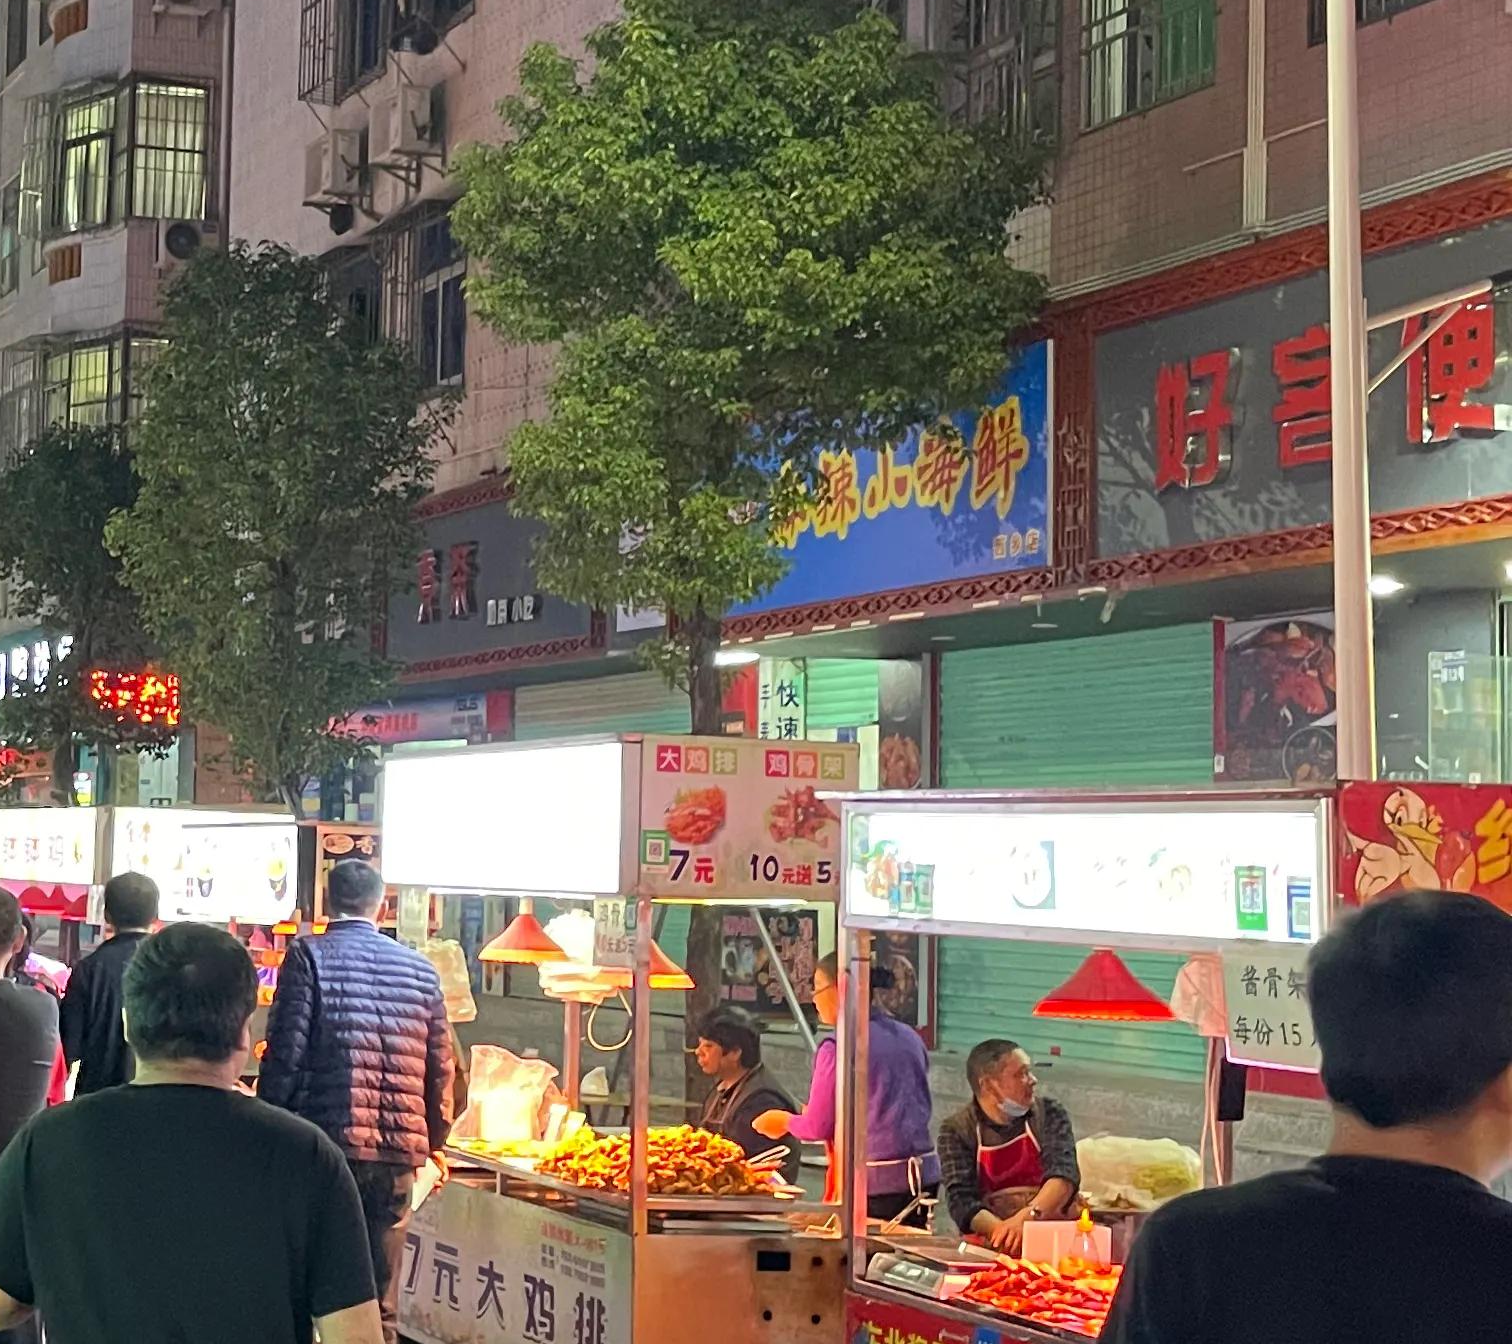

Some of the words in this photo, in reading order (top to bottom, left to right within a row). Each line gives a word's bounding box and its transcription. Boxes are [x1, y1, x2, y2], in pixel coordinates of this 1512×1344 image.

[657, 745, 737, 774] 大鸡排
[765, 750, 845, 779] 鸡骨架
[669, 849, 715, 884] 7元
[750, 853, 839, 886] 10元送5
[1233, 1015, 1317, 1047] 每份15
